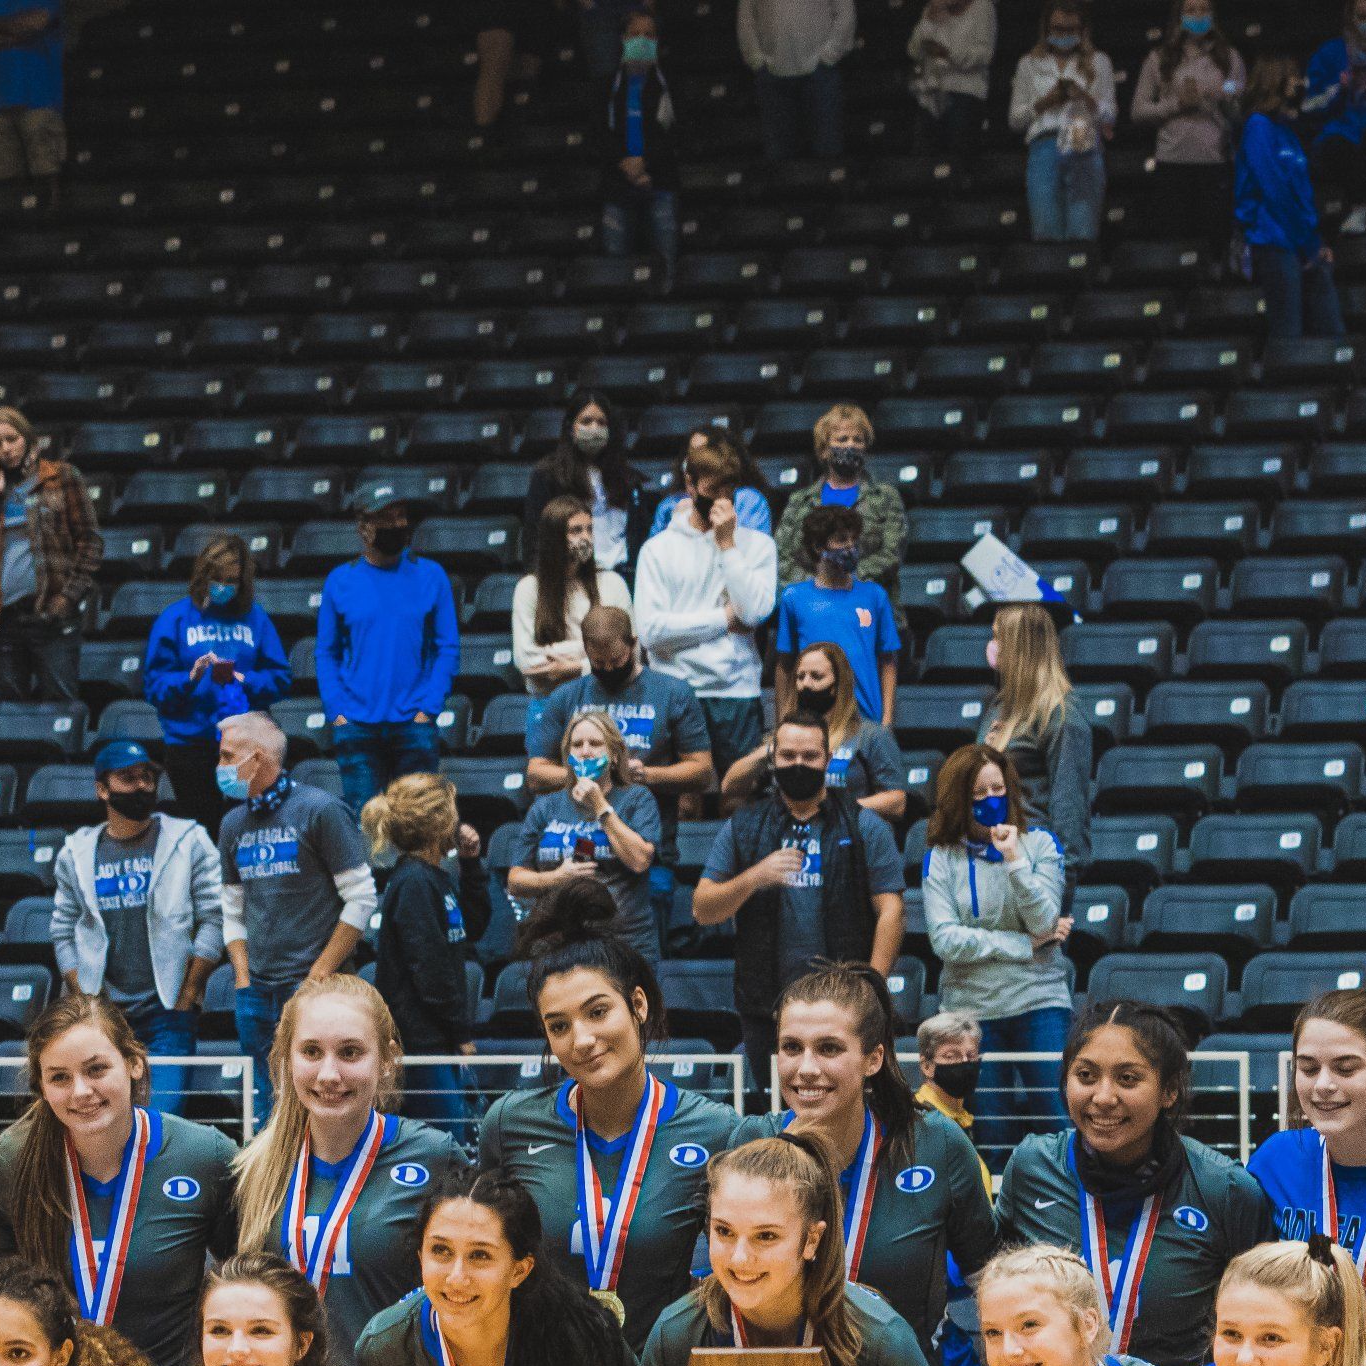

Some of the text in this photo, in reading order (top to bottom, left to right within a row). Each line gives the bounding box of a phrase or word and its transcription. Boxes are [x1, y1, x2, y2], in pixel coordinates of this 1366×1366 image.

[671, 1145, 707, 1167] D
[392, 1164, 427, 1186] D
[897, 1167, 933, 1191] D
[165, 1178, 198, 1199] D
